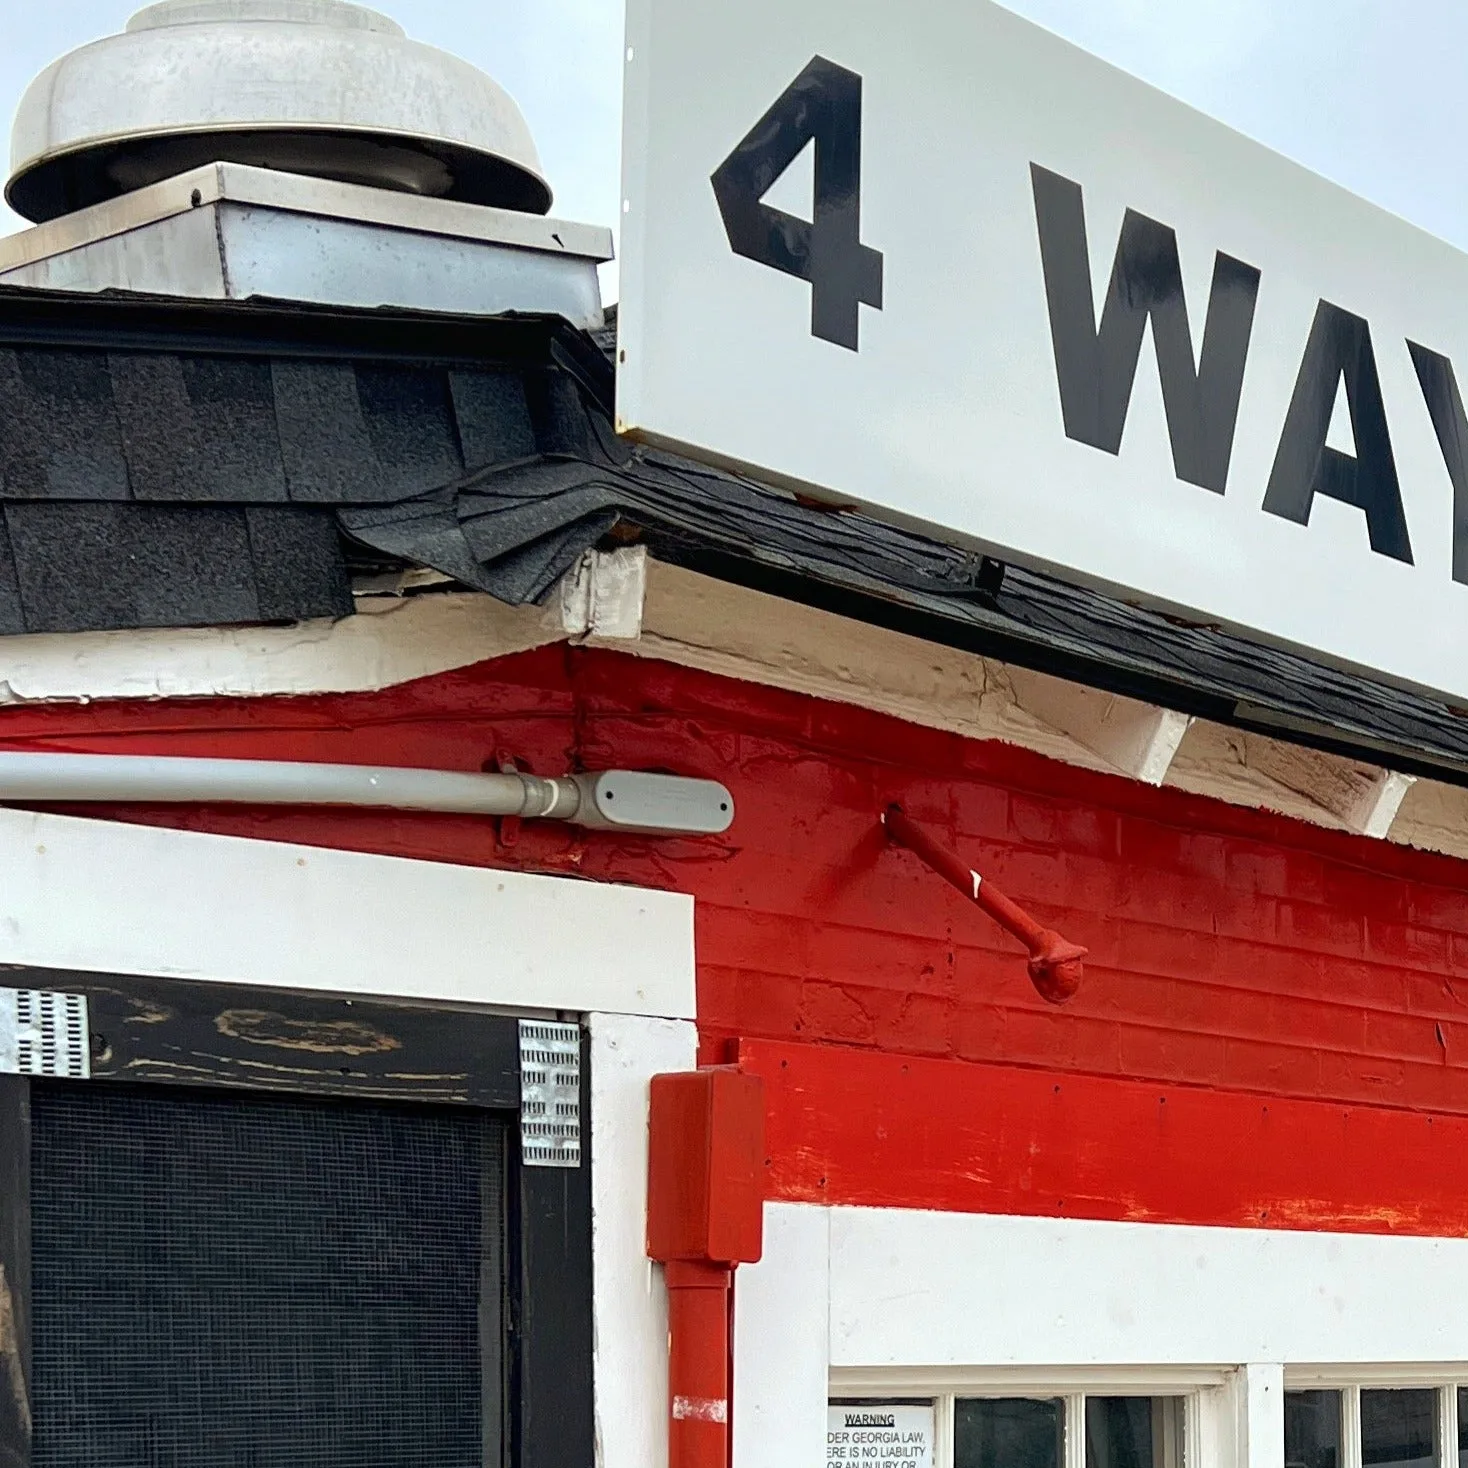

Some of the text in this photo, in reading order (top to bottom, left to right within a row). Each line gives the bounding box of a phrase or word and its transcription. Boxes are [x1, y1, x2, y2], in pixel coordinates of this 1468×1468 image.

[711, 54, 883, 353] 4
[845, 1414, 895, 1427] WARNING
[852, 1432, 900, 1443] GEORGIA
[849, 1447, 859, 1458] IS
[862, 1447, 878, 1458] NO
[880, 1446, 926, 1457] LIABILITY
